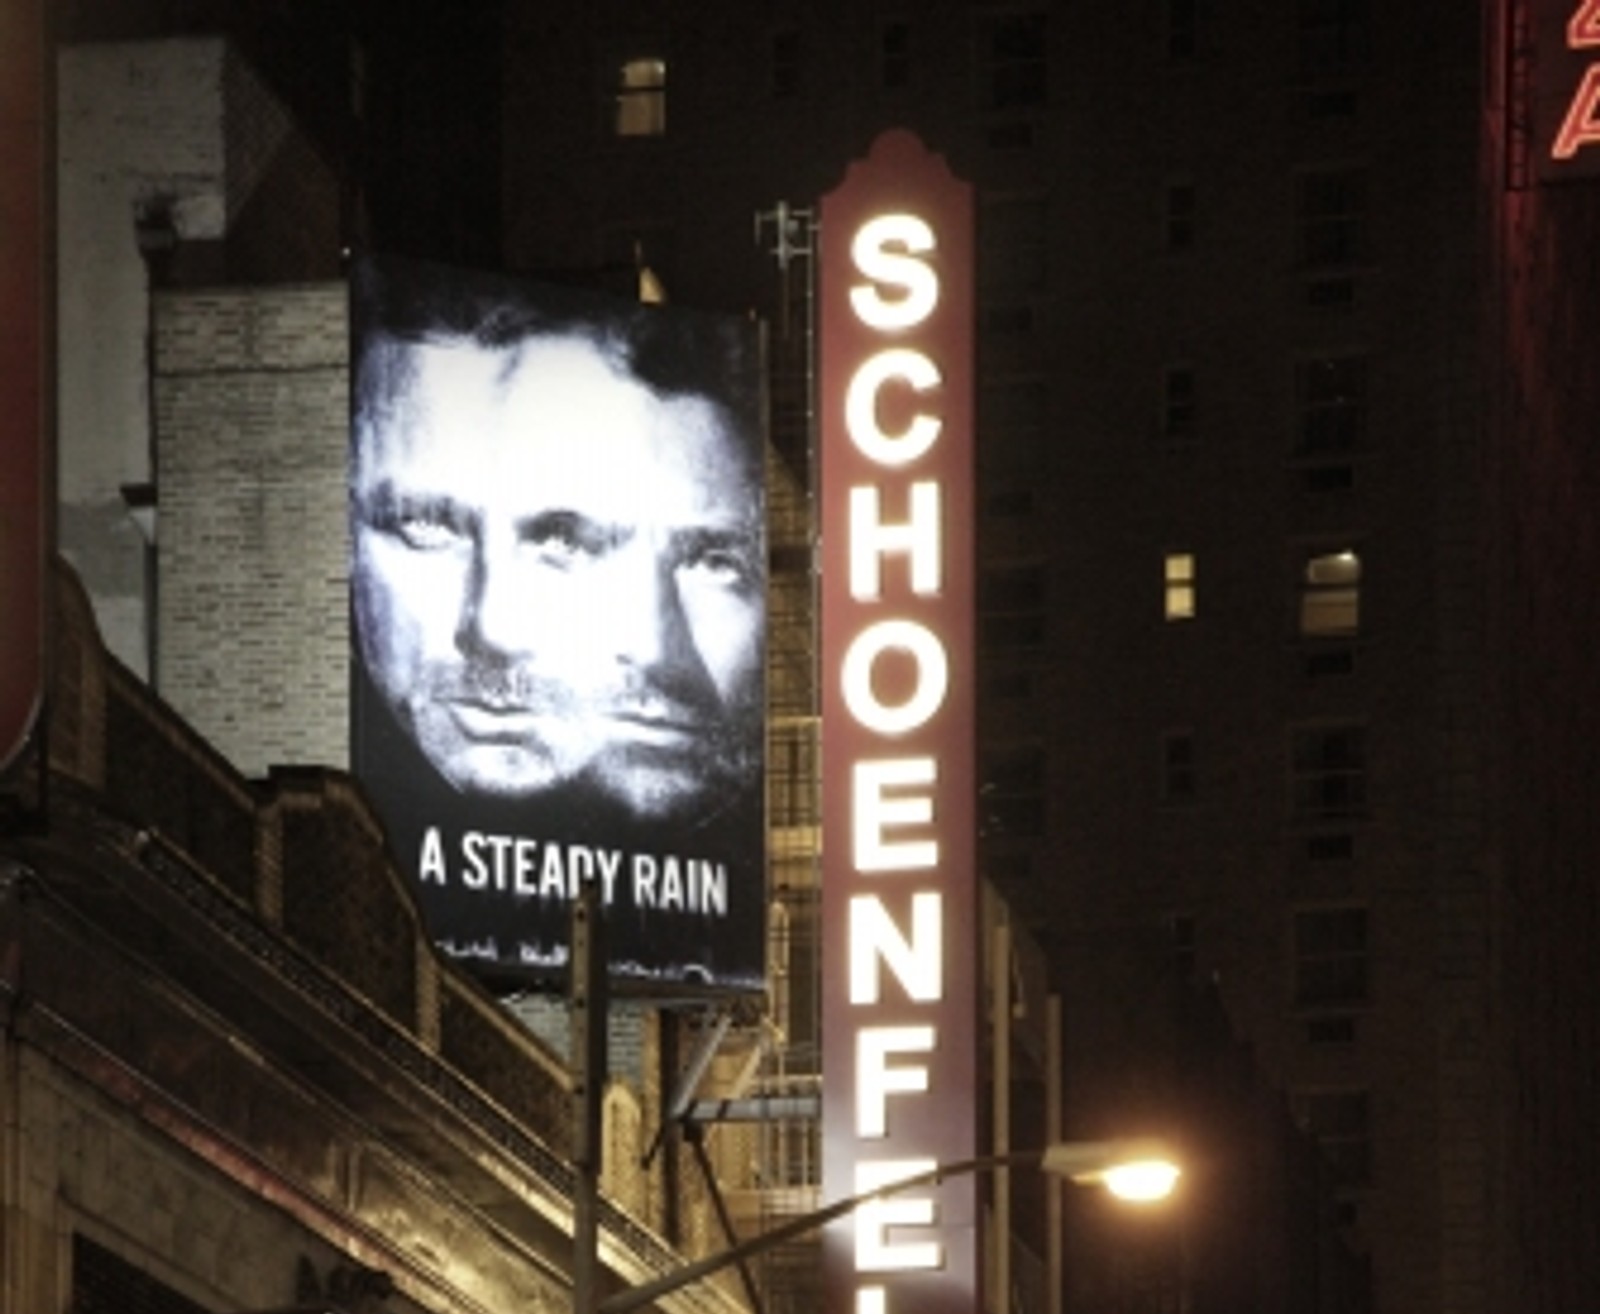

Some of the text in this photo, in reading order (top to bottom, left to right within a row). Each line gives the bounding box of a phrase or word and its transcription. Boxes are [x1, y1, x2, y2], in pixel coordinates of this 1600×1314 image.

[419, 826, 728, 916] A STEADY RAIN
